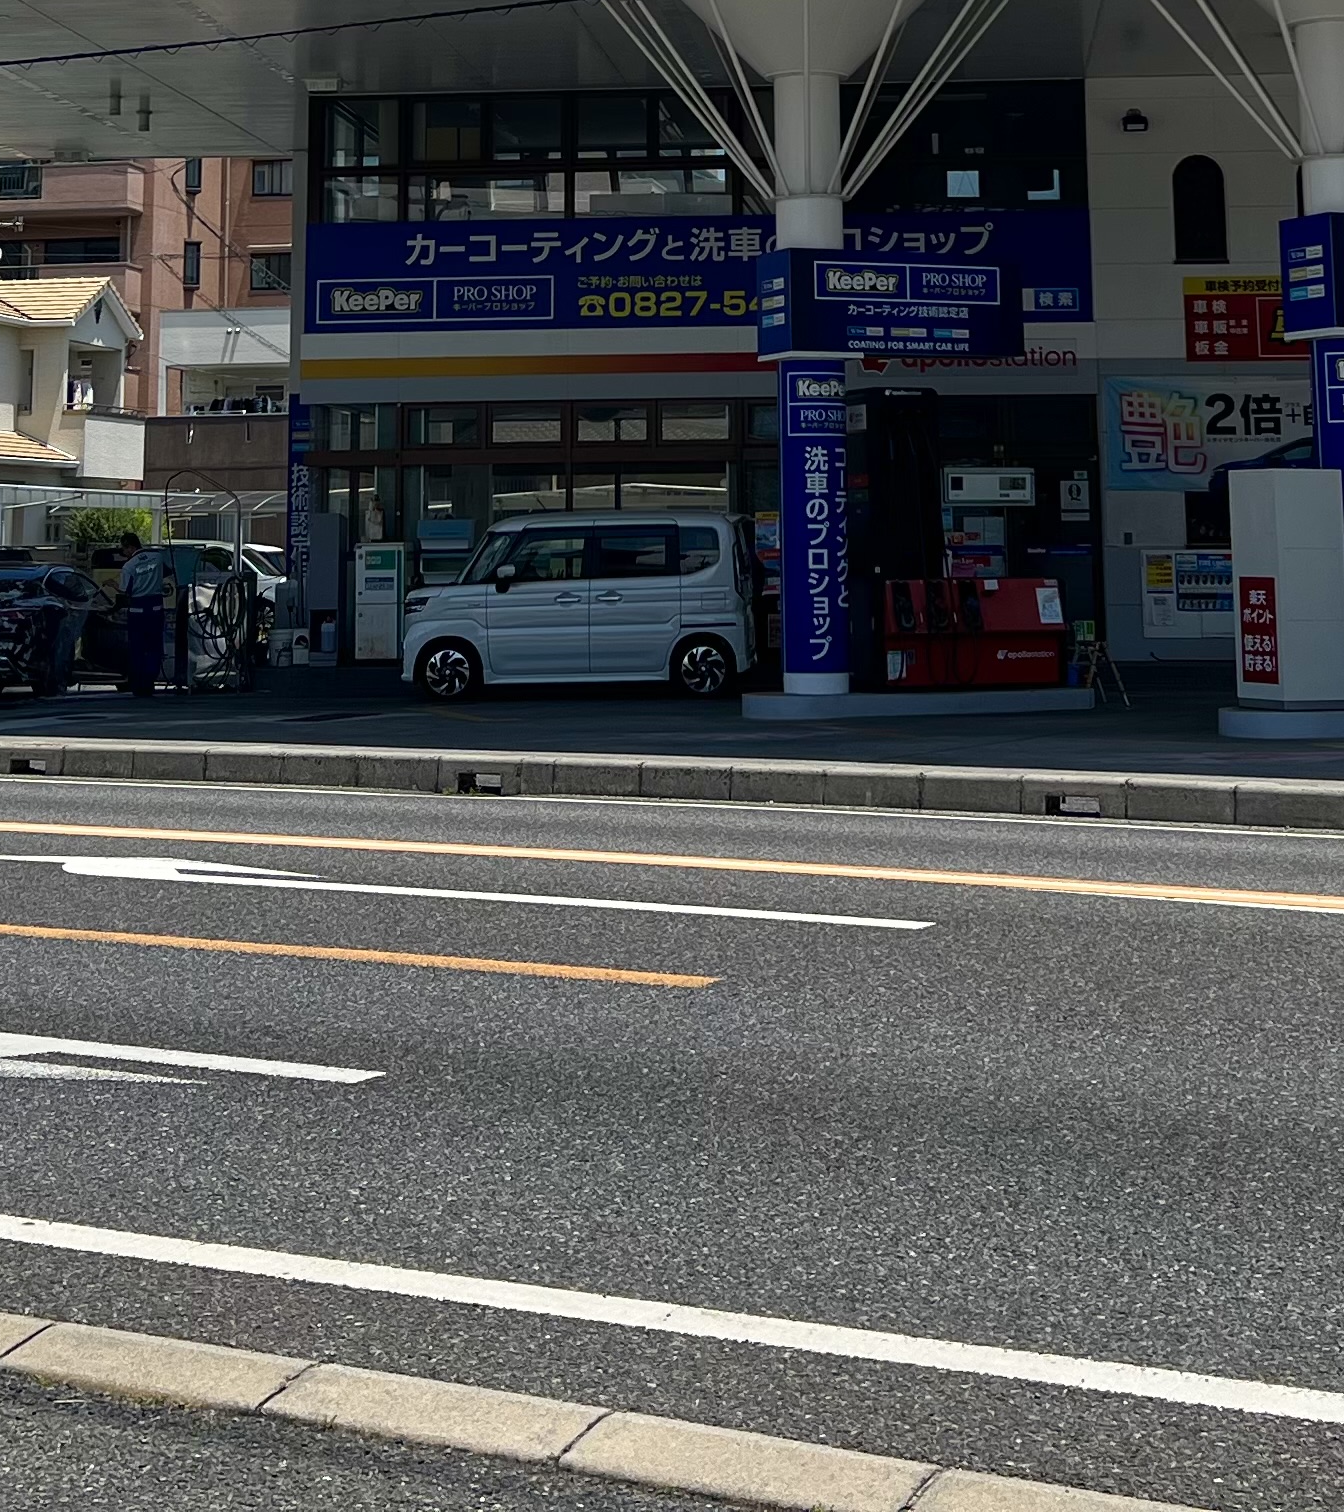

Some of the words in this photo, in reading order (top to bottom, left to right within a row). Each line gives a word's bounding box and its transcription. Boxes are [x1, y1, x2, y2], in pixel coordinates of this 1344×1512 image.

[577, 275, 703, 289] ご予約・お問い合わせは
[827, 269, 898, 294] KeePer
[922, 272, 949, 287] PRO
[952, 273, 987, 288] SHOP
[331, 288, 423, 313] KeePer
[453, 286, 487, 302] PRO
[491, 284, 536, 301] SHOP
[1039, 291, 1073, 307] 検索
[848, 303, 969, 319] カーコーティング技術認定店
[848, 339, 885, 350] COATING
[888, 340, 904, 350] FOR
[906, 341, 934, 351] SMART
[936, 342, 953, 351] CAR
[955, 342, 969, 352] LIFE
[800, 409, 826, 421] PRO
[1206, 393, 1283, 436] 2倍
[804, 445, 832, 660] 洗車のプロショップ
[1243, 608, 1274, 624] ポイント
